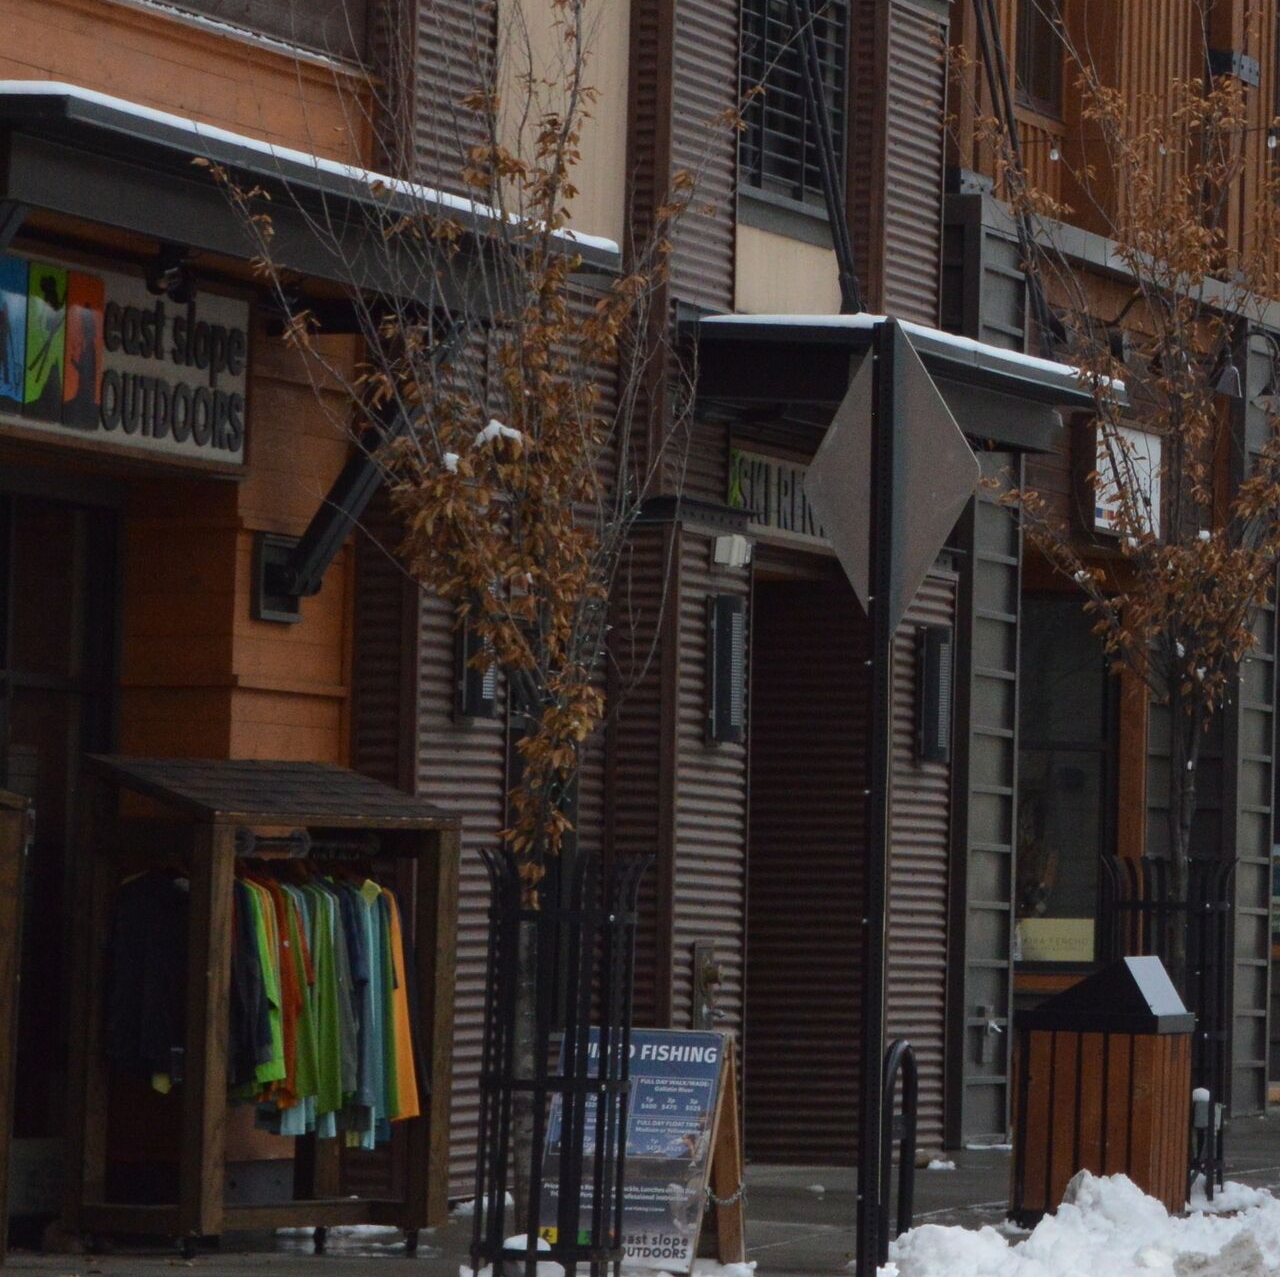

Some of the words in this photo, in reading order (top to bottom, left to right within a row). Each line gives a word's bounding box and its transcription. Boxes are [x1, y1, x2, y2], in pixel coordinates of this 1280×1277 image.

[104, 300, 166, 361] east
[172, 300, 246, 388] slope
[101, 369, 245, 453] OUTDOORS
[640, 1043, 718, 1064] FISHING
[652, 1233, 689, 1250] slope
